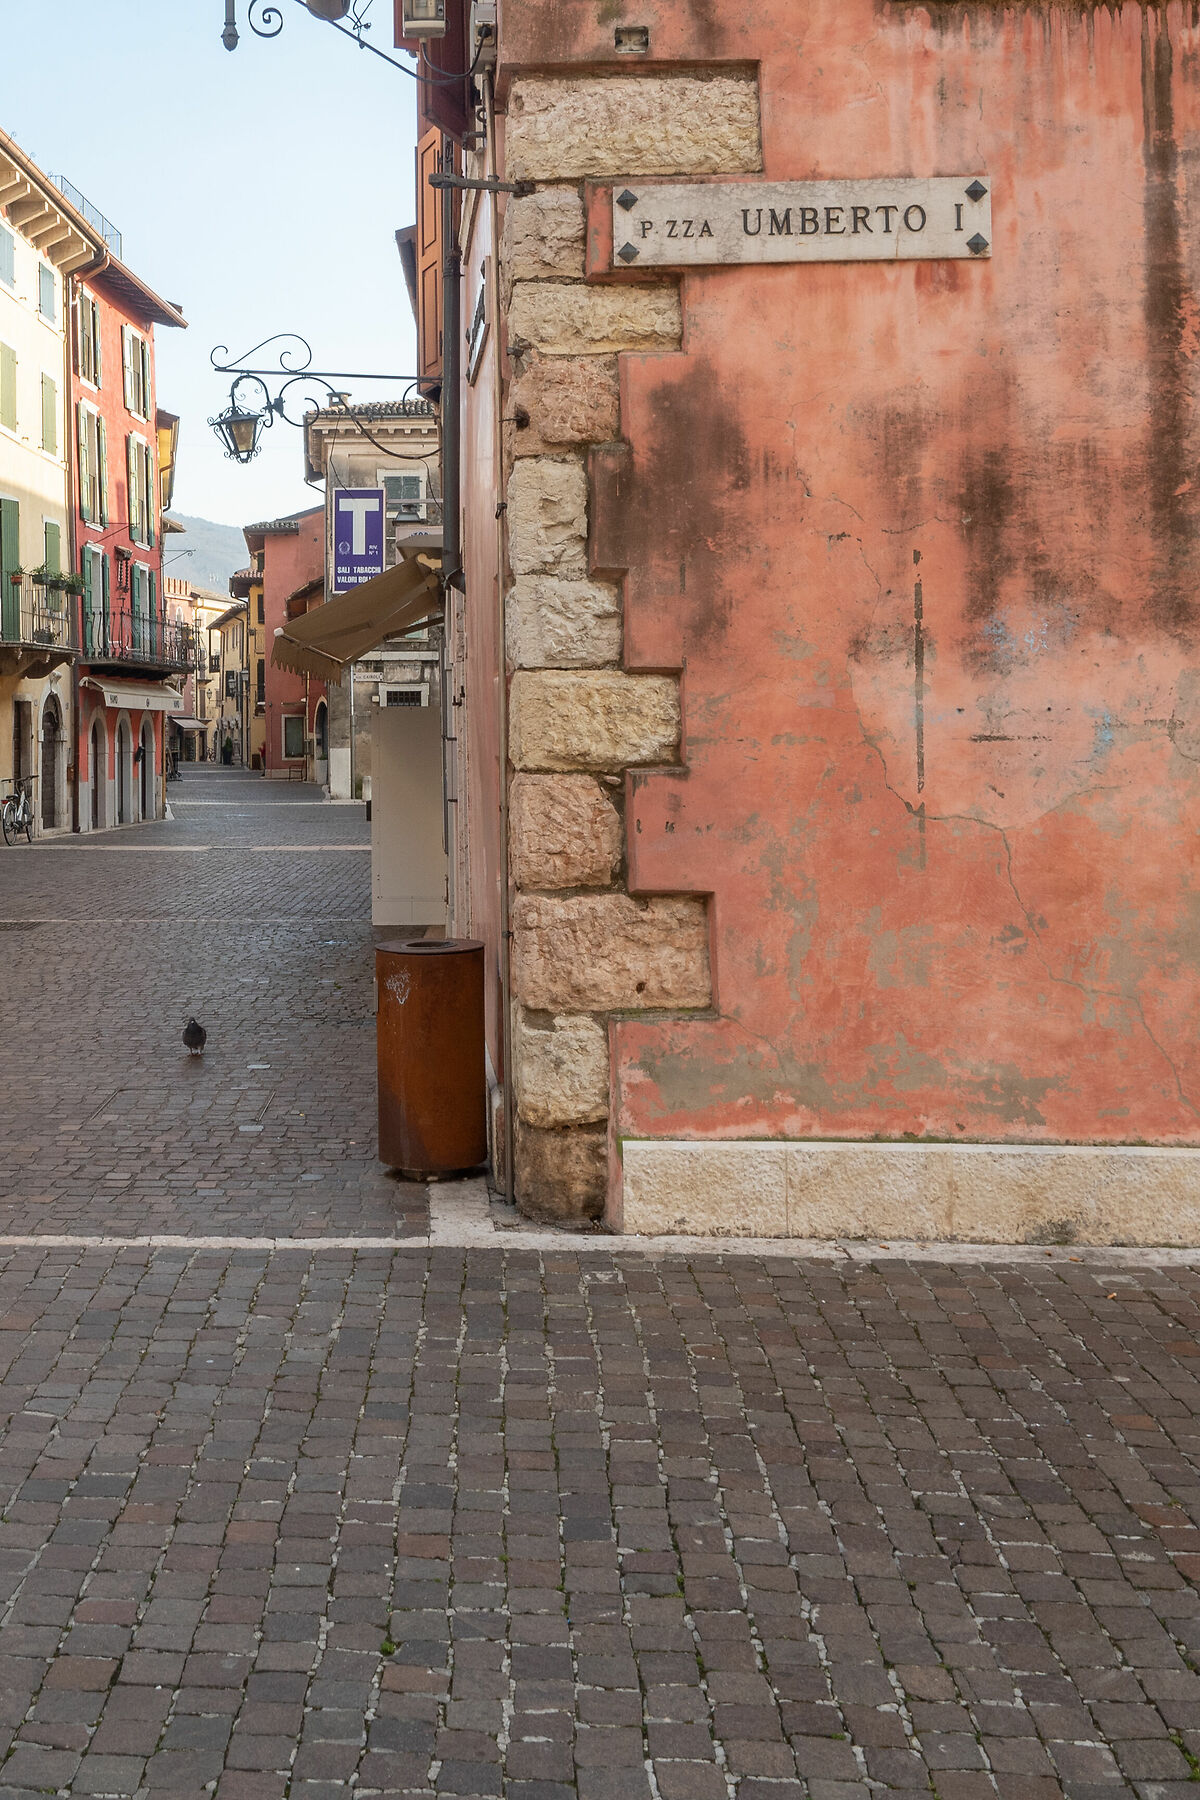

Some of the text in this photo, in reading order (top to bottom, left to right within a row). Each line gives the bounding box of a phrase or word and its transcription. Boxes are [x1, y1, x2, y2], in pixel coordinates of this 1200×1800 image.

[740, 203, 927, 236] UMBERTO
[953, 203, 965, 232] I
[339, 498, 379, 555] T
